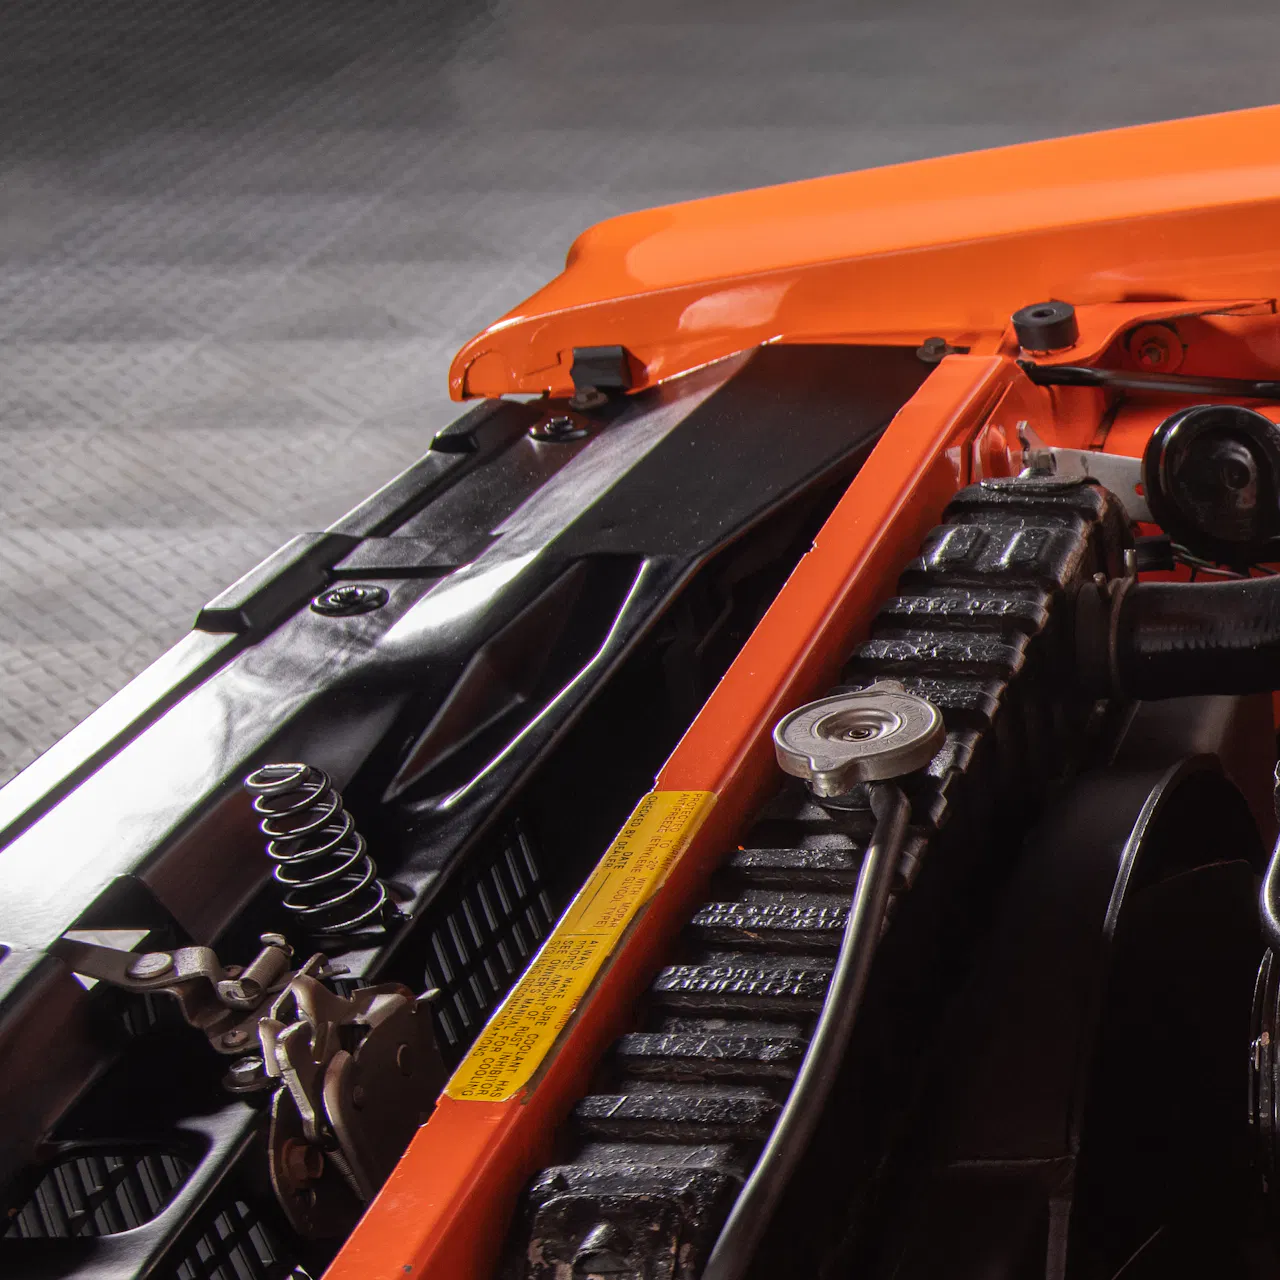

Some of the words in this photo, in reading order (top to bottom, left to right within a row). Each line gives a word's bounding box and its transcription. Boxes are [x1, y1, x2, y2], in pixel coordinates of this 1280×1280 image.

[628, 795, 659, 826] CHECKED
[654, 793, 690, 832] ANTIFREEZE
[667, 793, 702, 832] PROTECTED
[620, 829, 636, 838] BY
[657, 839, 673, 848] TO
[612, 851, 634, 869] DATE
[629, 836, 663, 872] (ETHYLENE
[609, 876, 637, 903] GLYCOL
[627, 877, 649, 895] WITH
[592, 907, 617, 928] TYPE)
[605, 902, 632, 928] MOPAR
[555, 940, 574, 954] SEE
[558, 940, 587, 969] PROPER
[569, 940, 599, 970] ALWAYS
[527, 959, 561, 993] OWNER'S
[551, 977, 576, 998] MAKE
[533, 974, 564, 1005] AMOUNT
[503, 998, 536, 1029] MANUAL
[523, 1010, 541, 1020] OF
[533, 1005, 558, 1026] SURE
[488, 1035, 511, 1052] FOR
[505, 1026, 531, 1047] RUST
[503, 1033, 540, 1073] COOLANT
[459, 1057, 497, 1095] COOLING
[487, 1080, 510, 1097] HAS
